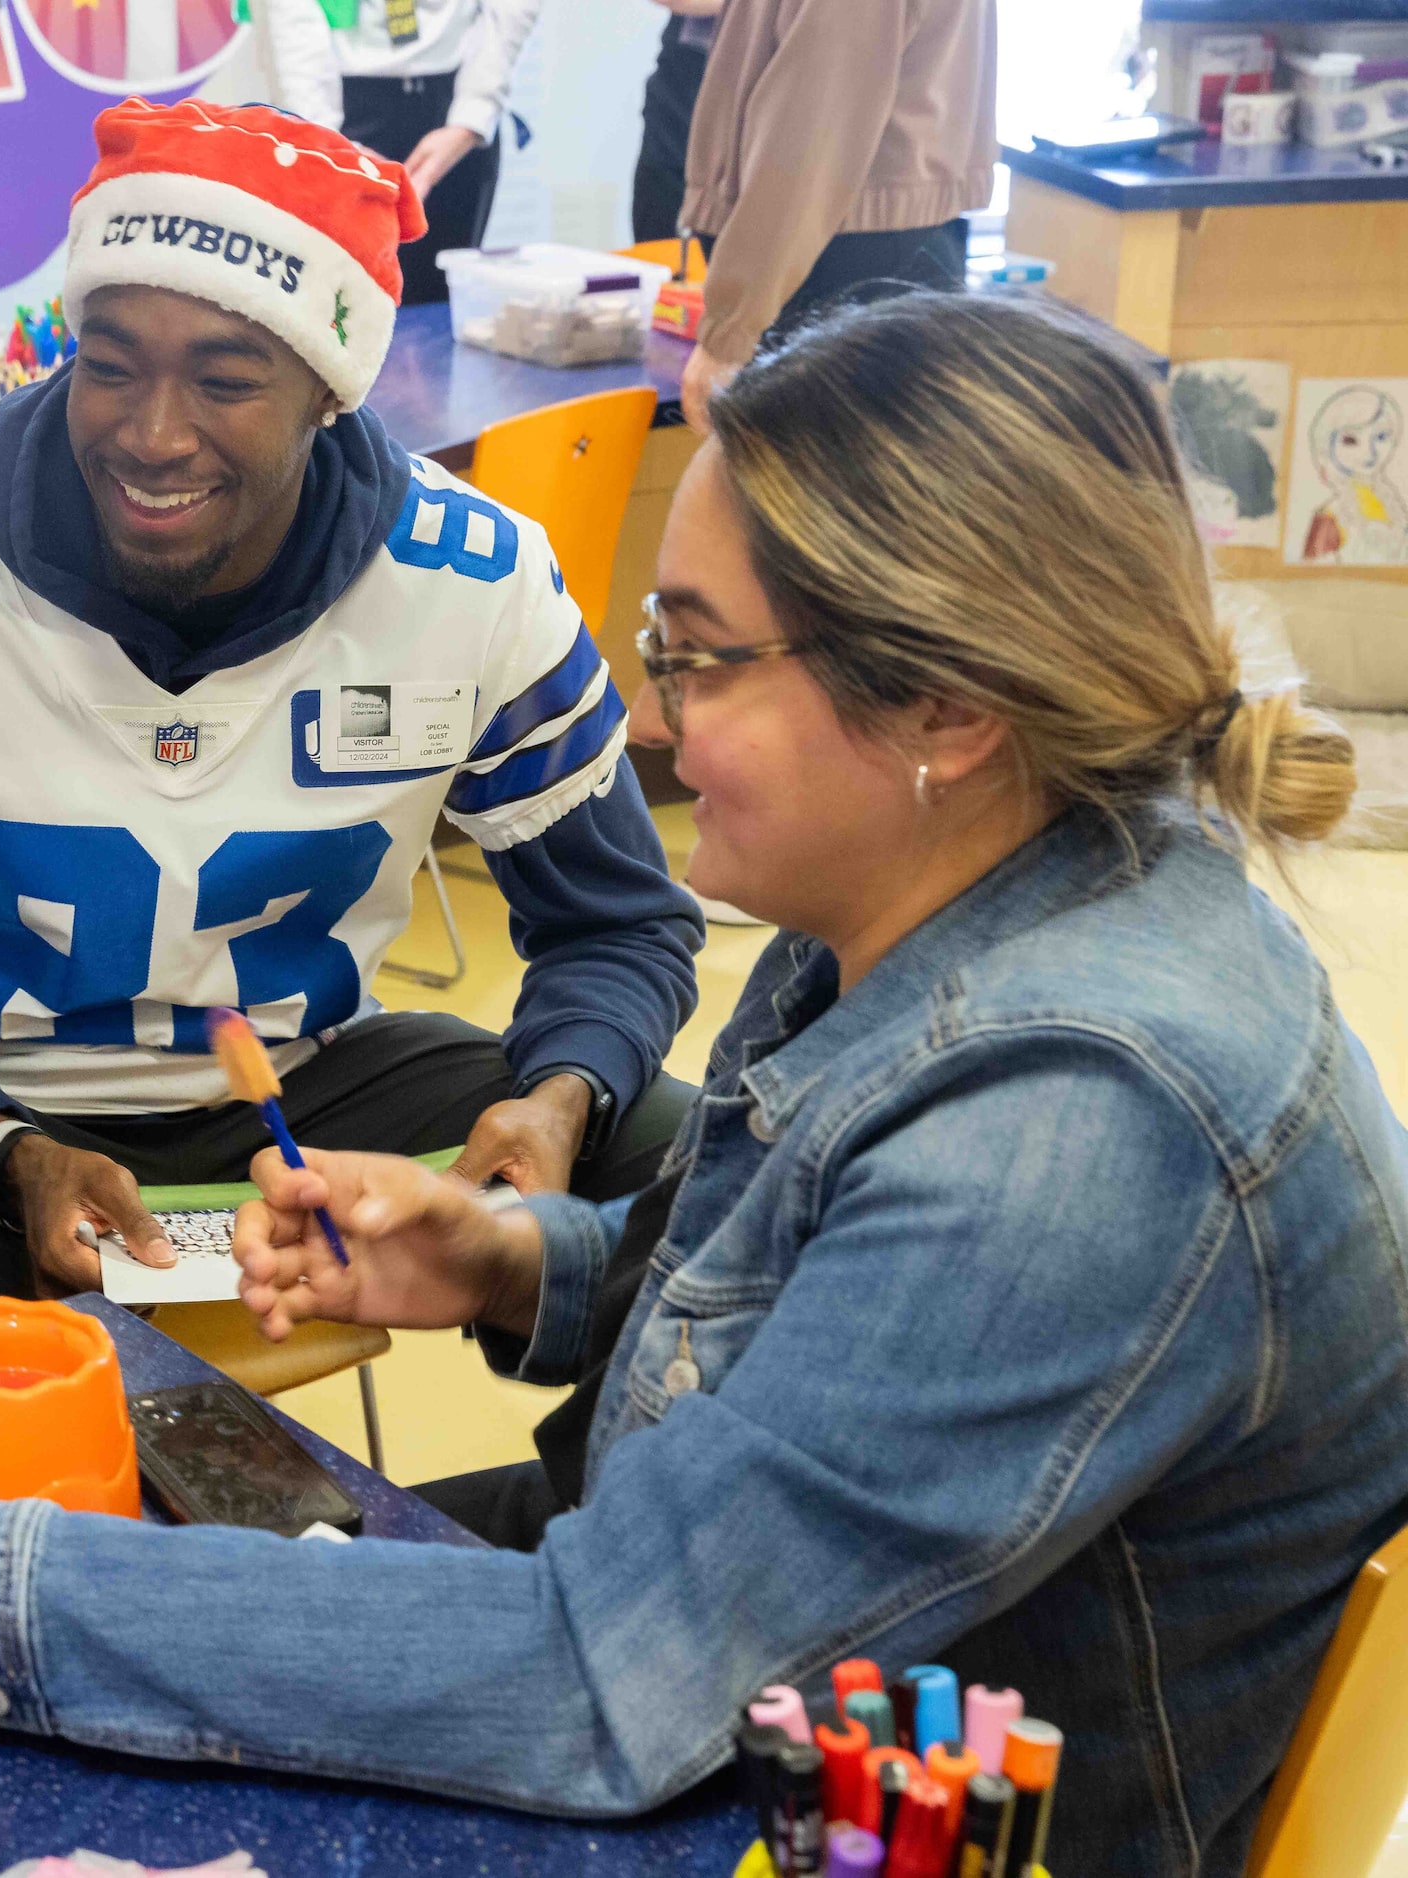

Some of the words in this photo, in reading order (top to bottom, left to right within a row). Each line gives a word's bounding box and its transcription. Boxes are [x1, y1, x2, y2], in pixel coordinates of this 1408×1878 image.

[102, 214, 304, 294] COWBOYS
[386, 457, 518, 583] 8
[426, 723, 450, 731] SPECIAL
[428, 732, 449, 740] GUEST
[353, 738, 384, 746] VISITOR
[159, 742, 193, 761] NFL
[434, 747, 453, 755] LOBBY
[349, 752, 389, 762] 12/02/2024
